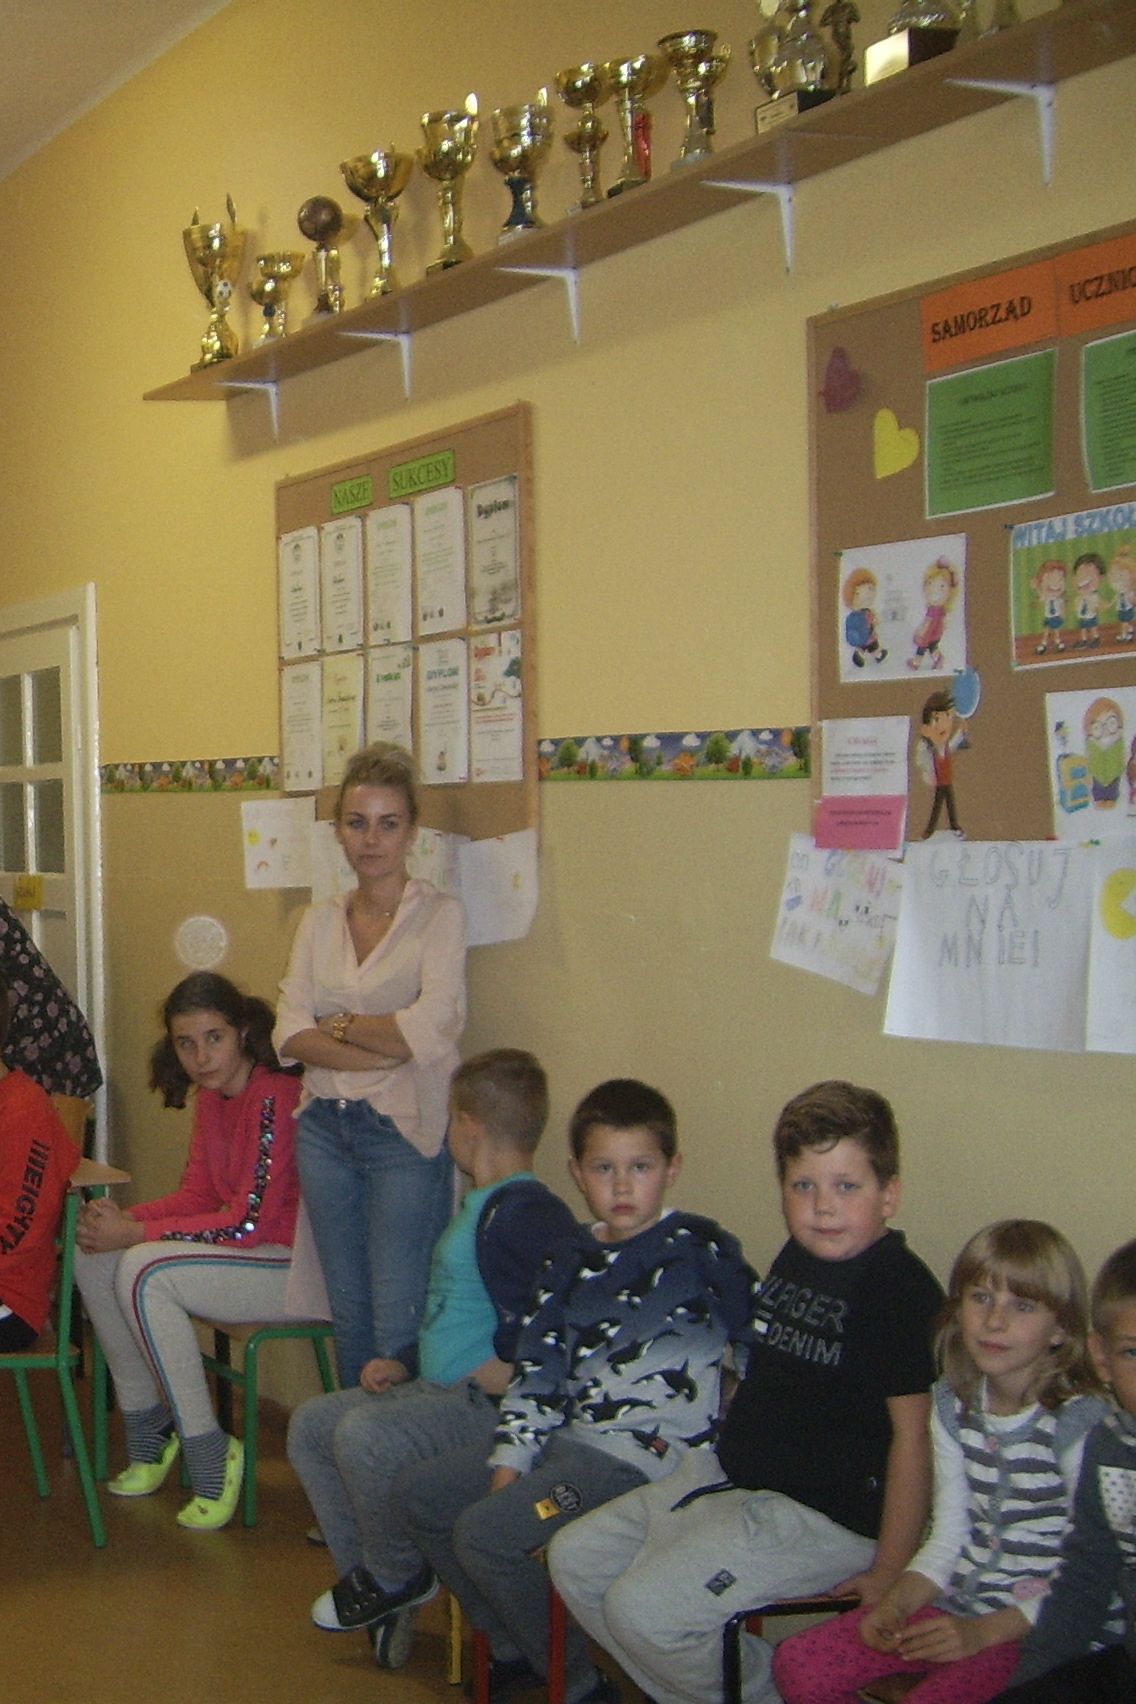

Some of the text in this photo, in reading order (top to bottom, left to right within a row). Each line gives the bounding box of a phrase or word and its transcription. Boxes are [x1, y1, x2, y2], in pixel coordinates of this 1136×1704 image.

[333, 457, 452, 506] NASZE SUKCESY
[966, 886, 1018, 932] NA
[767, 1321, 844, 1365] DENIM
